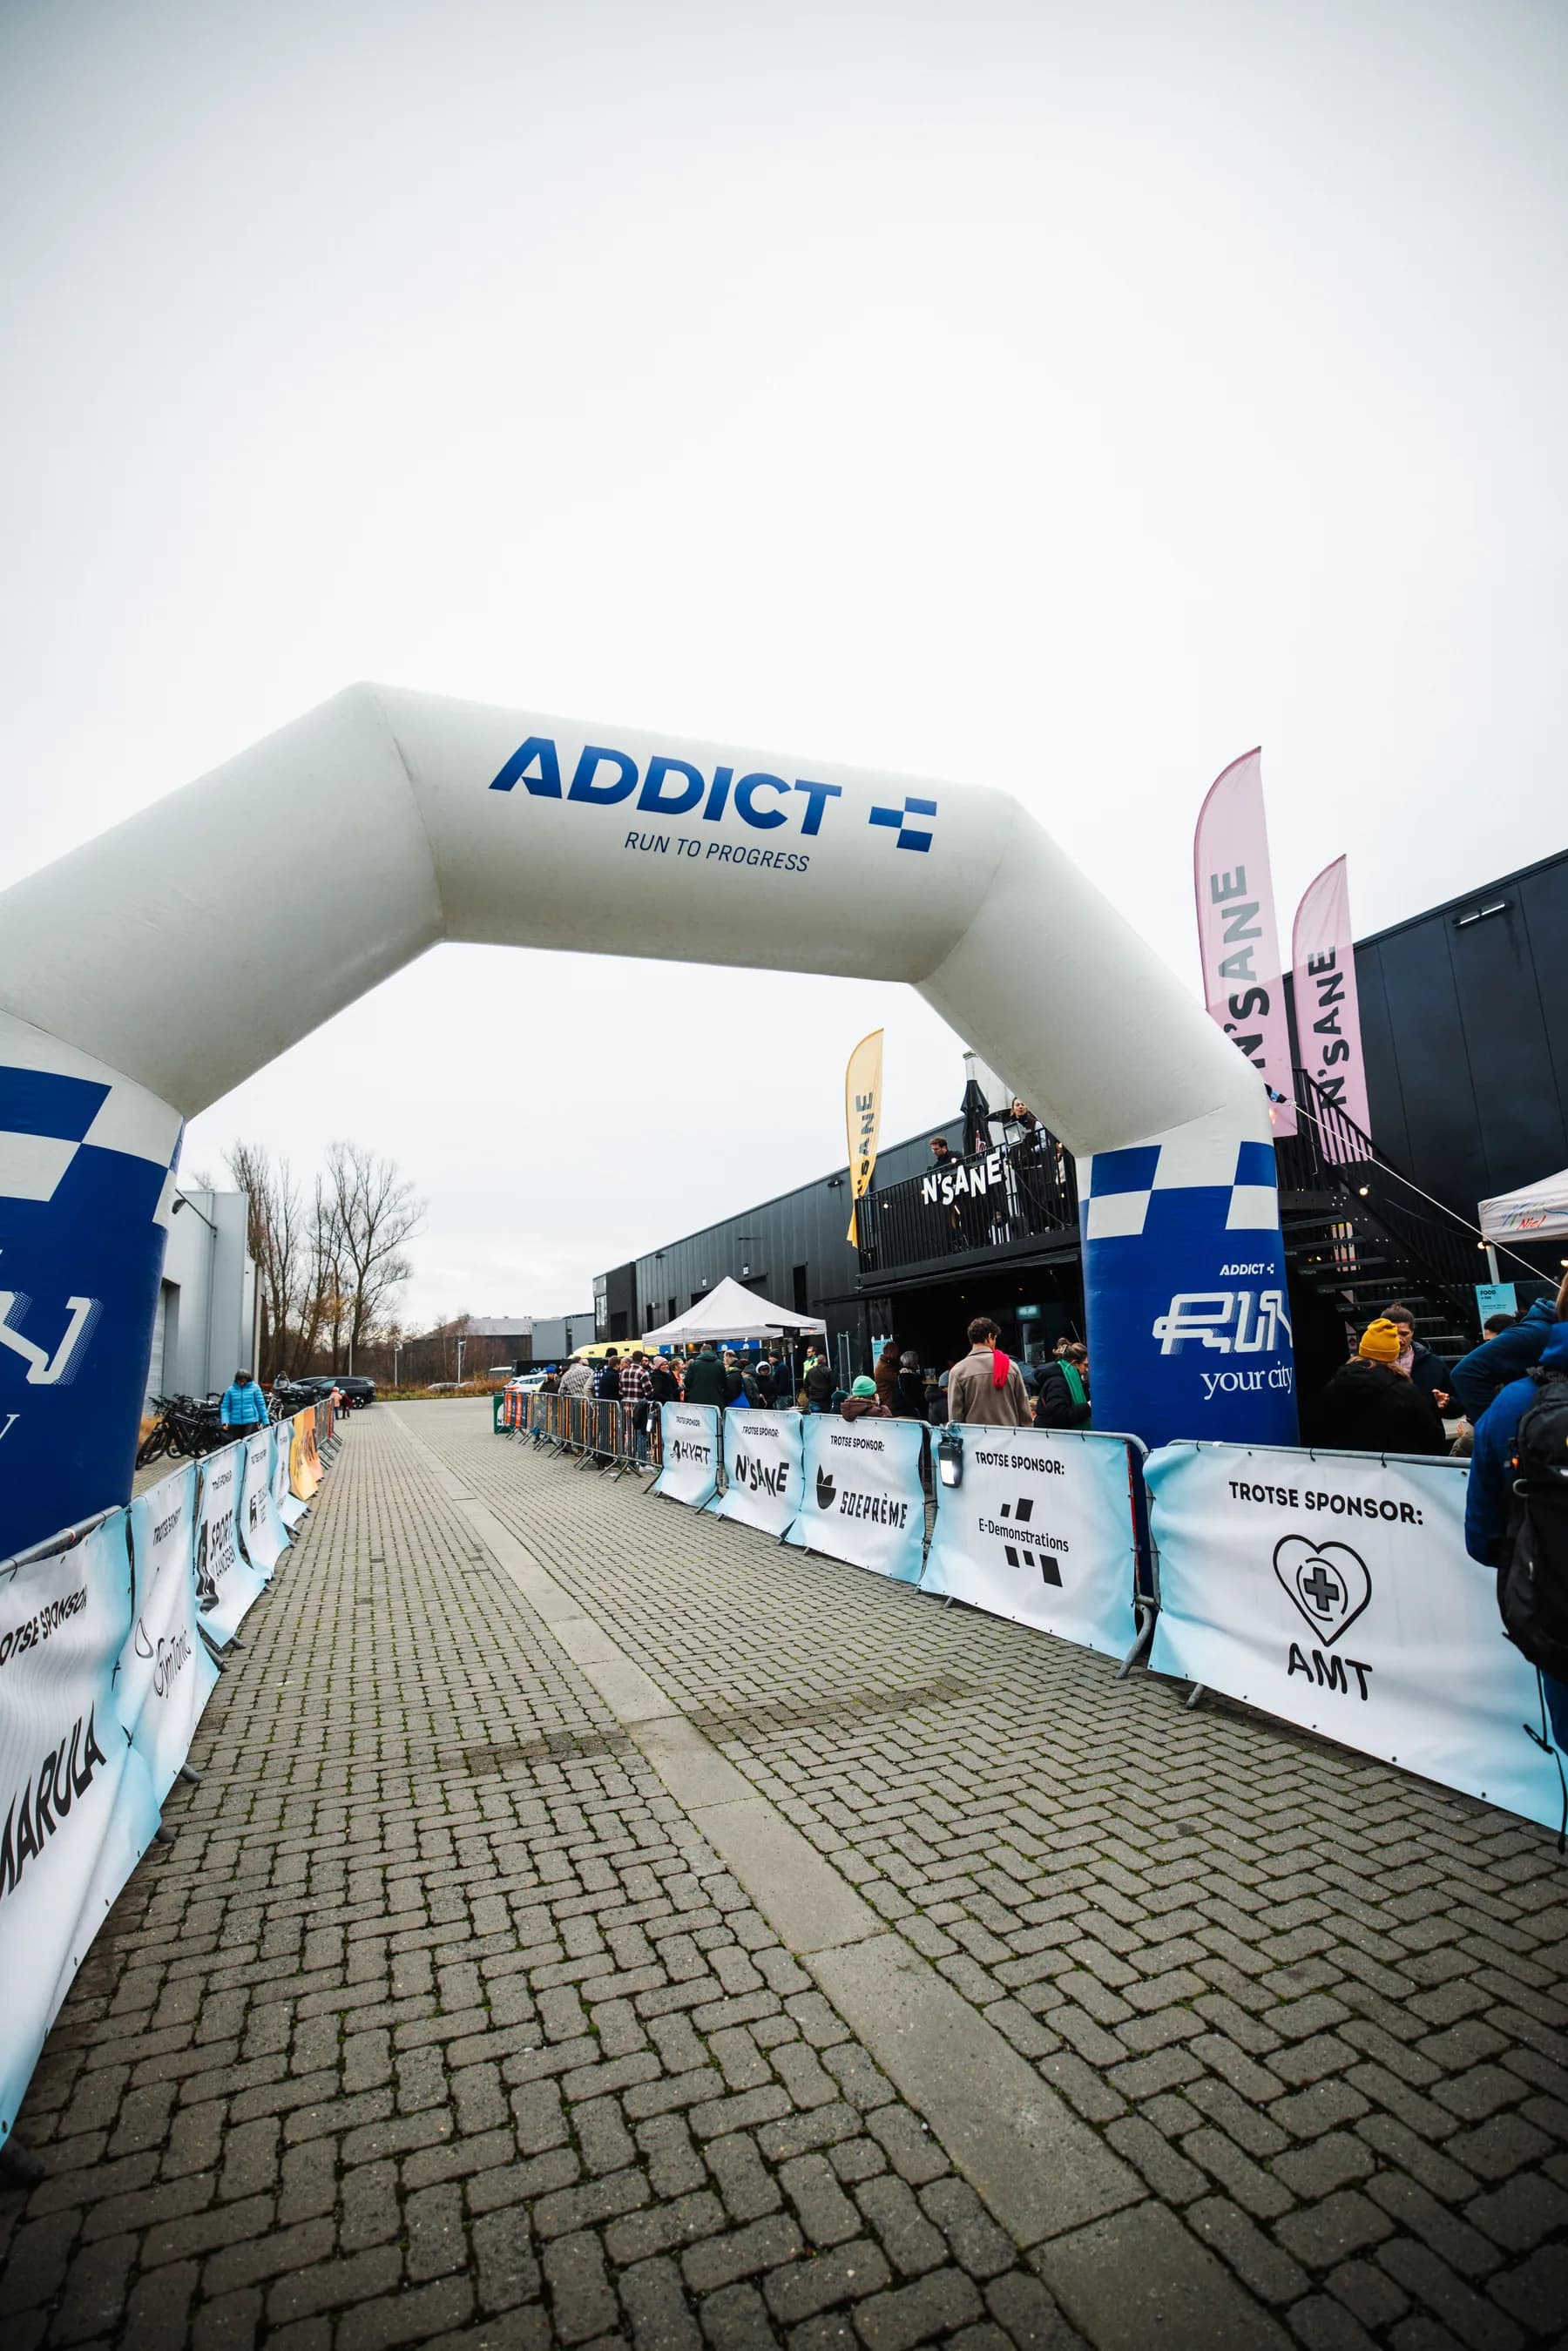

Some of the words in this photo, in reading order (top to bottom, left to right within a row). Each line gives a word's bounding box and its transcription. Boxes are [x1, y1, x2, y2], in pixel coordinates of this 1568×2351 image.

[488, 736, 842, 835] ADDICT
[625, 832, 670, 853] RUN
[677, 838, 701, 857] TO
[706, 843, 809, 872] PROGRESS
[1308, 946, 1349, 1110] N'SANE
[923, 1147, 1002, 1205] N'SANE
[1220, 1264, 1264, 1275] ADDICT
[1200, 1370, 1265, 1400] your
[1268, 1361, 1293, 1394] city
[742, 1426, 759, 1436] TROTSE
[831, 1436, 851, 1447] TROTSE
[853, 1438, 884, 1452] SPONSOR:
[735, 1454, 789, 1497] N'SANE
[976, 1452, 1009, 1467] TROTSE
[1011, 1457, 1064, 1475] SPONSOR:
[1229, 1482, 1299, 1508] TROTSE
[1305, 1491, 1423, 1525] SPONSOR:
[978, 1518, 1069, 1552] E-Demonstrations
[1288, 1643, 1373, 1701] AMT
